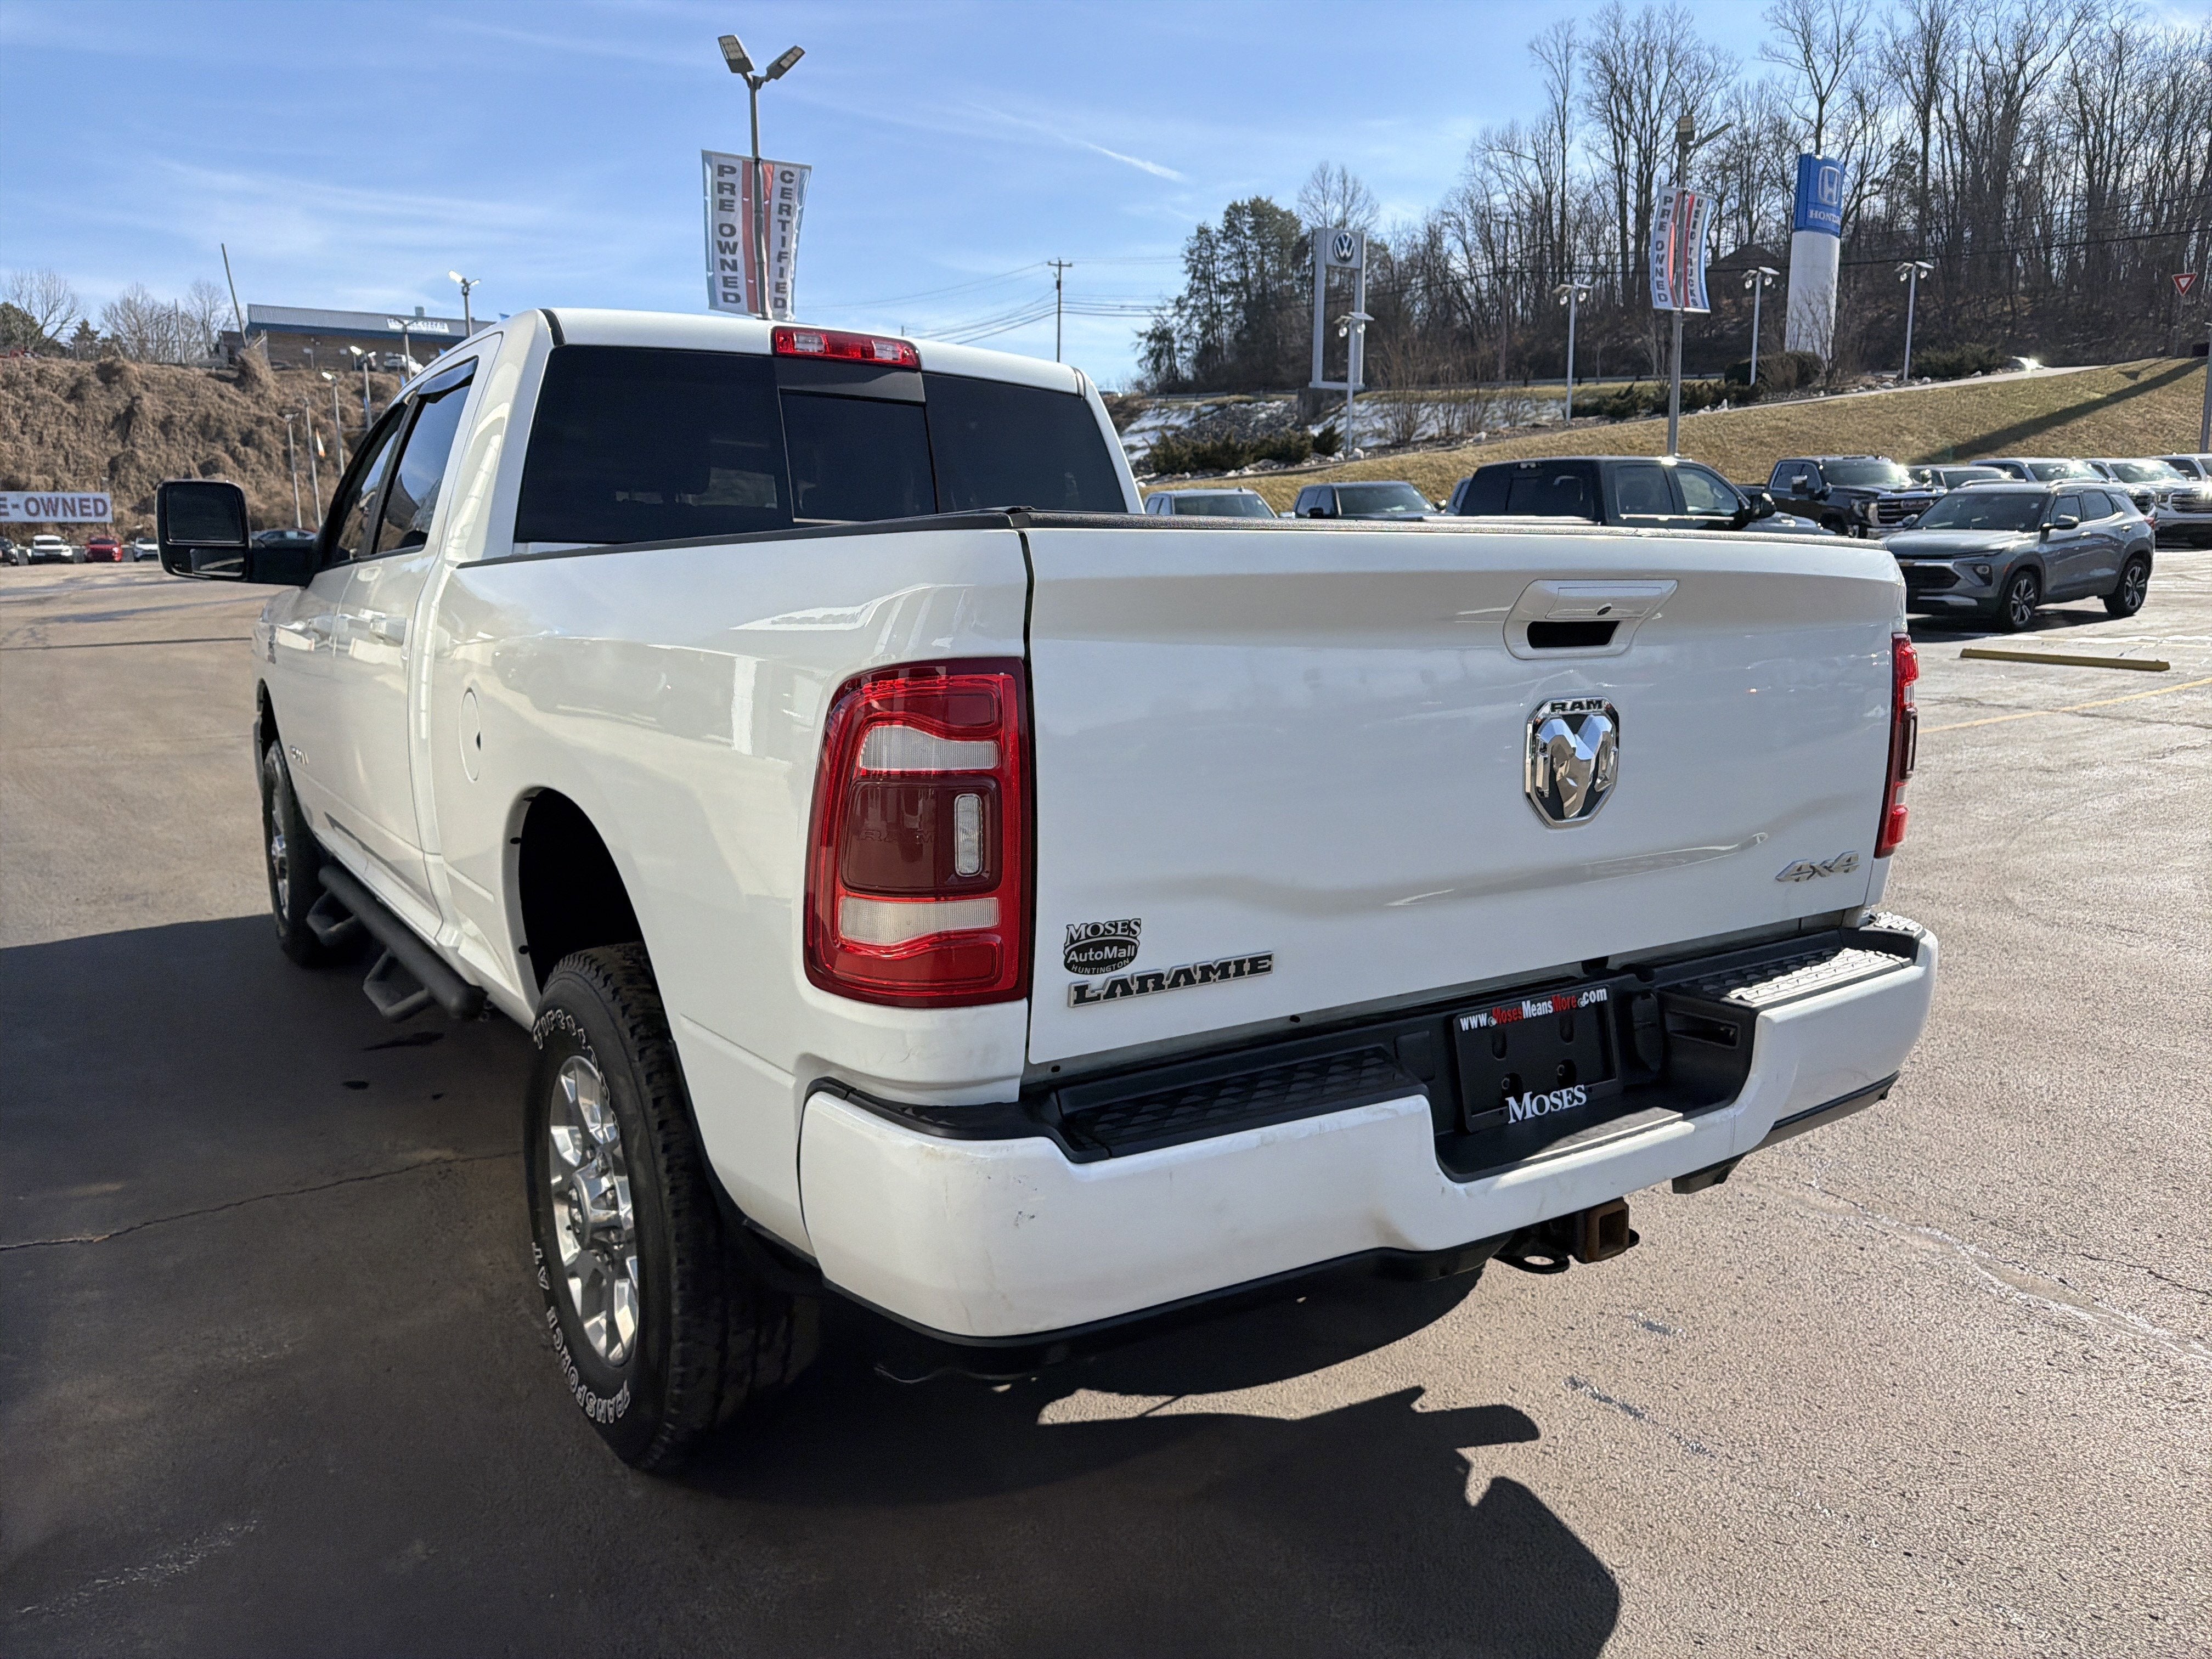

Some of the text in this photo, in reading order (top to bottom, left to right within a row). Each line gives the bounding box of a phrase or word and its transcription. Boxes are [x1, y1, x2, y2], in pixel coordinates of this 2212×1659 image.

[717, 164, 741, 304] PRE OWNED
[773, 170, 795, 309] CERTIFIED
[1655, 195, 1673, 302] PRE OWNED
[1550, 699, 1604, 713] RAM
[1064, 919, 1141, 947] MOSES
[1066, 944, 1135, 964] AutoMall
[1071, 958, 1130, 974] HUNTINGTON
[1068, 951, 1274, 1007] LARAMIE
[1505, 1085, 1587, 1124] MOSES
